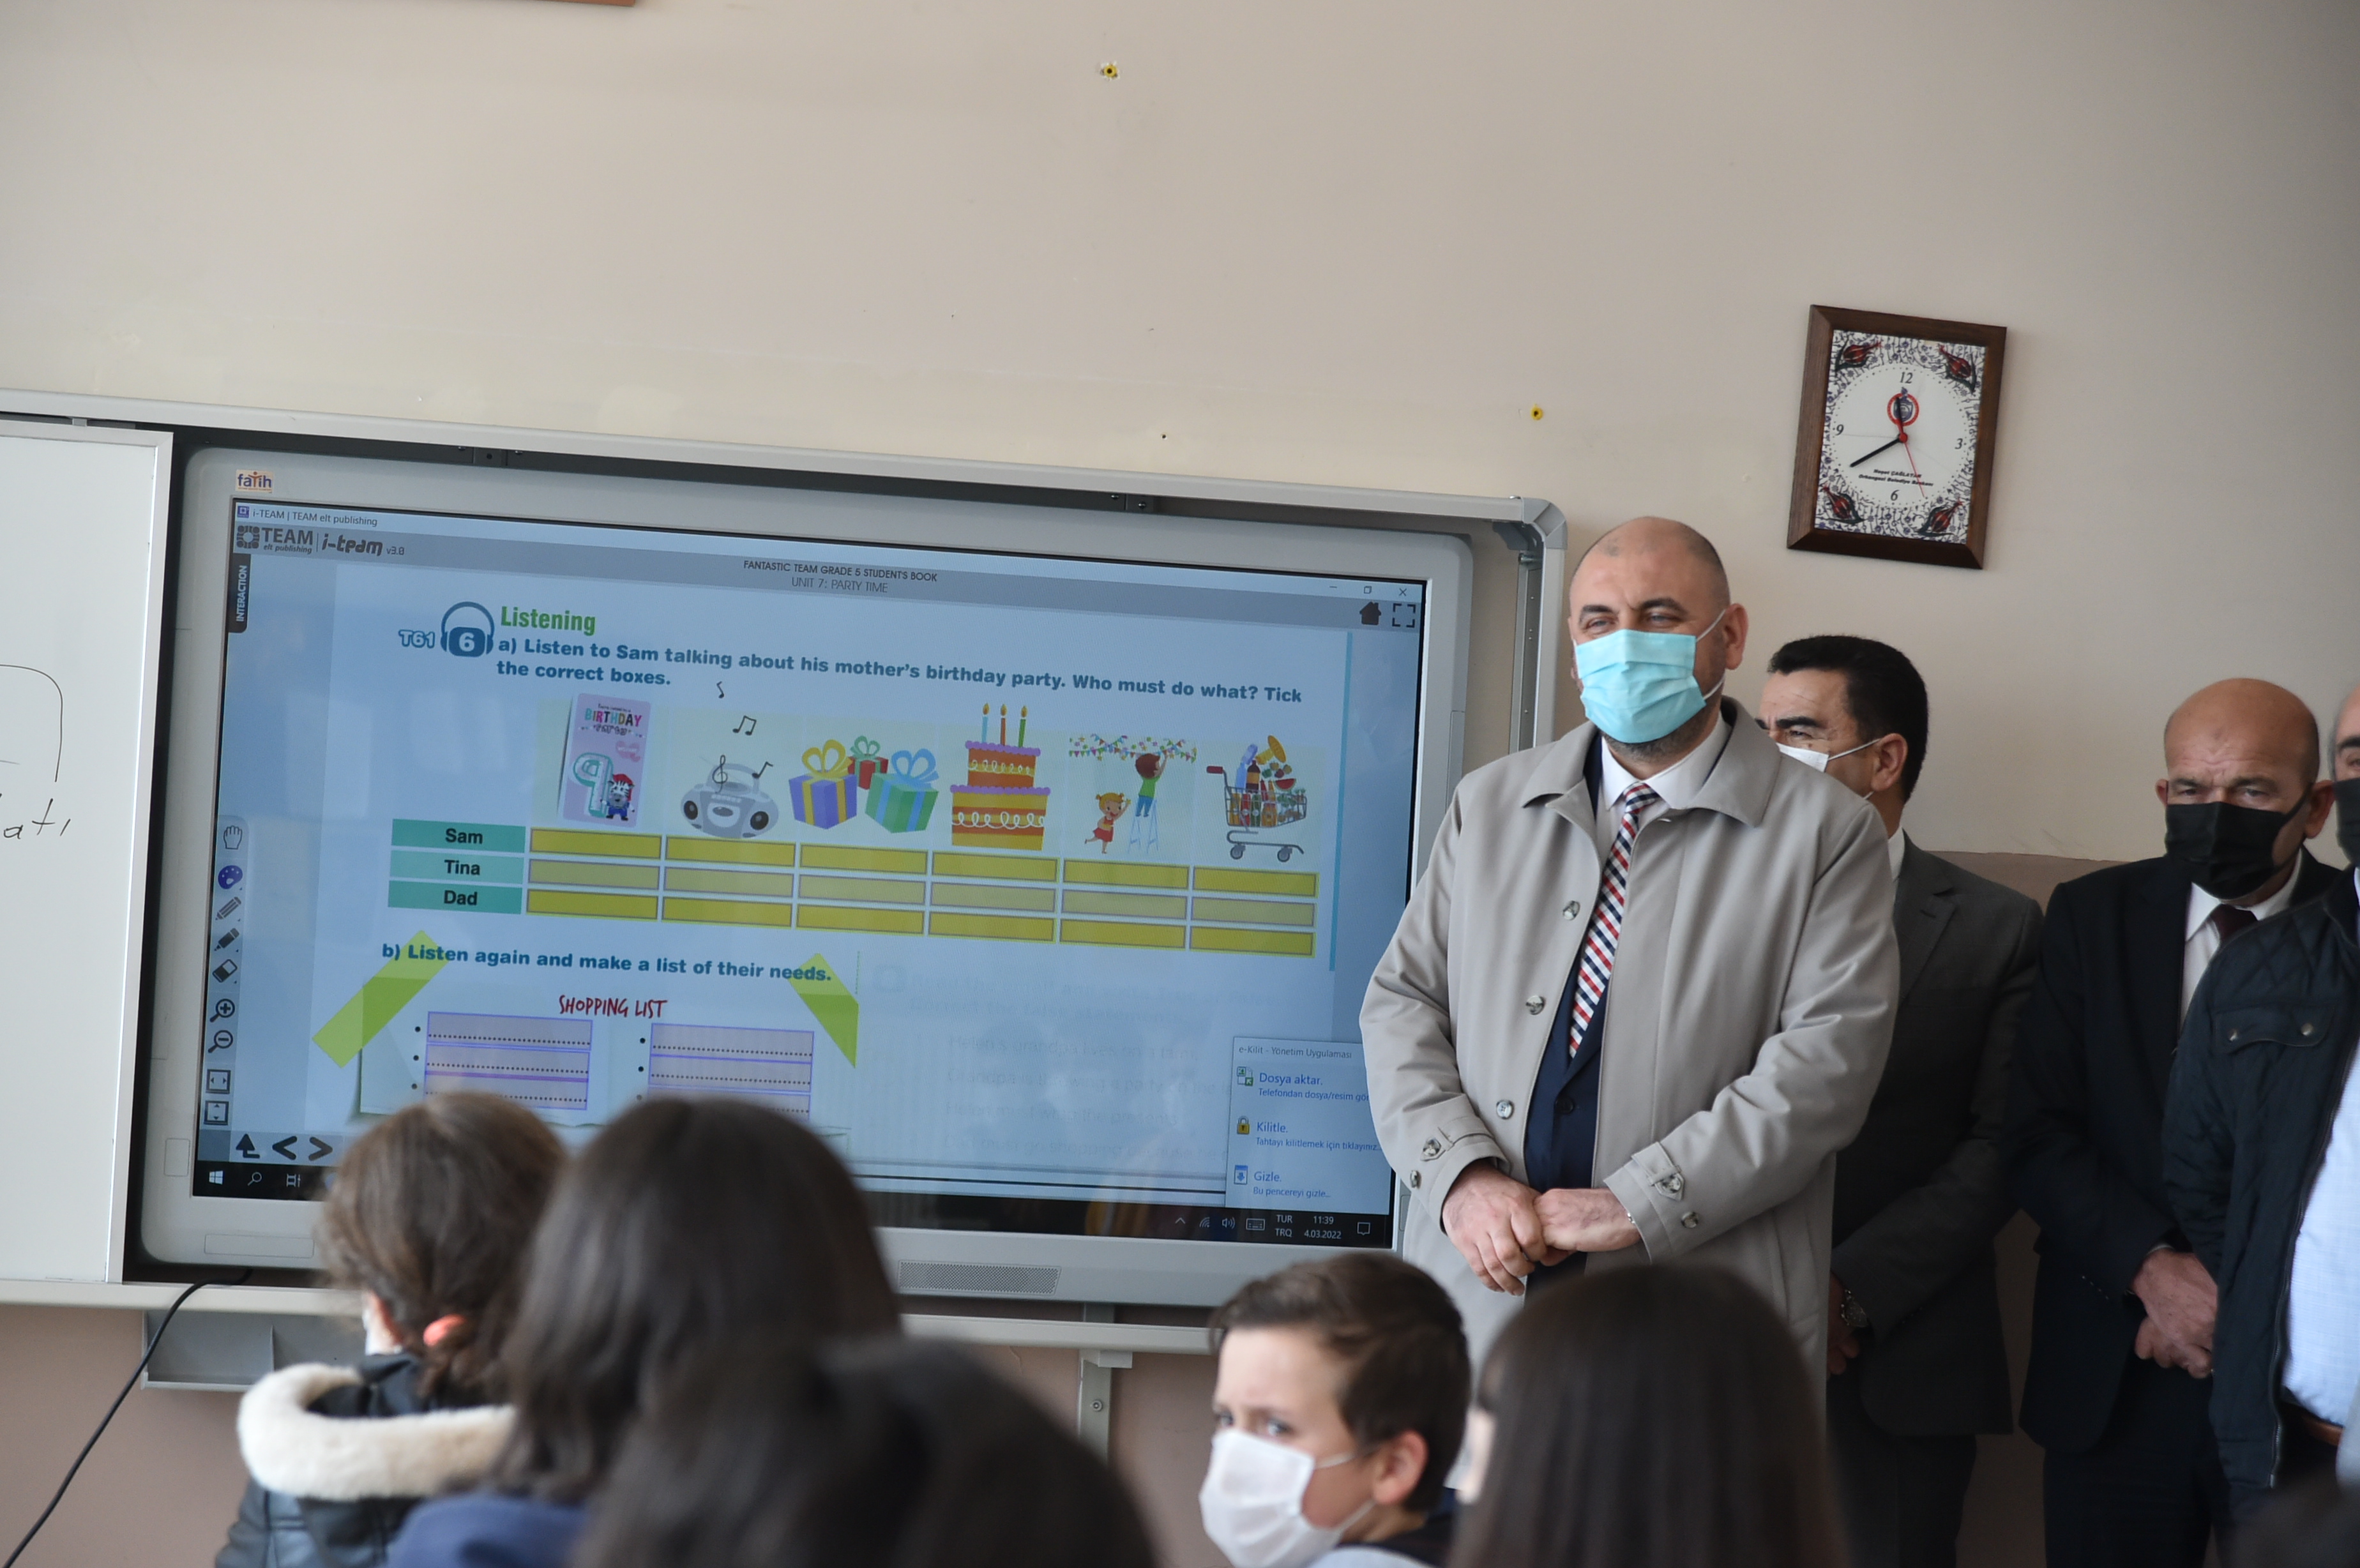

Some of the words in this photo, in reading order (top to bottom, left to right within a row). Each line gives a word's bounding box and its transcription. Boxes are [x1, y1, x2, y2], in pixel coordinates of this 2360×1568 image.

[1899, 372, 1913, 384] 12
[1835, 425, 1844, 436] 9
[1955, 439, 1963, 451] 3
[1891, 490, 1900, 501] 6
[253, 509, 285, 518] i-TEAM
[292, 512, 317, 522] TEAM
[319, 513, 331, 522] elt
[333, 515, 378, 527] publishing
[262, 527, 313, 545] TEAM
[275, 545, 312, 554] publishing
[386, 546, 405, 555] v3.0
[743, 561, 790, 571] FANTASTIC
[794, 564, 818, 573] TEAM
[820, 566, 852, 576] GRADE
[911, 571, 937, 582] BOOK
[791, 577, 814, 587] UNIT
[818, 578, 828, 589] 7:
[831, 579, 863, 591] PARTY
[865, 582, 888, 593] TIME
[236, 565, 248, 622] INTERACTION
[501, 606, 596, 636] Listening
[398, 629, 435, 649] T61
[498, 640, 517, 655] a)
[524, 639, 584, 656] Listen
[590, 644, 610, 658] to
[616, 645, 658, 661] Sam
[665, 648, 732, 669] talking
[739, 654, 794, 670] about
[801, 656, 829, 672] his
[835, 661, 920, 679] mother's
[926, 665, 1006, 688] birthday
[1011, 672, 1066, 691] party.
[1073, 674, 1112, 691] Who
[1118, 681, 1165, 695] must
[1172, 682, 1194, 696] do
[1201, 684, 1259, 700] what?
[1264, 687, 1302, 702] Tick
[497, 661, 529, 677] the
[535, 666, 604, 682] correct
[610, 668, 671, 685] boxes.
[585, 708, 642, 727] BIRTHDAY
[445, 828, 483, 844] Sam
[444, 859, 480, 875] Tina
[444, 890, 478, 905] Dad
[382, 944, 401, 961] b)
[408, 945, 468, 961] Listen
[474, 951, 530, 967] again
[537, 954, 573, 967] and
[580, 956, 632, 970] make
[639, 960, 650, 971] a
[656, 958, 686, 973] list
[693, 960, 712, 974] of
[718, 961, 764, 977] their
[770, 965, 832, 981] needs.
[559, 995, 628, 1018] SHOPPING
[635, 1000, 668, 1018] LIST
[1271, 1047, 1304, 1057] Yönetim
[1306, 1049, 1352, 1059] Uygulaması
[1259, 1073, 1291, 1087] Dosya
[1294, 1074, 1324, 1086] aktar.
[1259, 1088, 1303, 1098] Telefondan
[1305, 1090, 1354, 1101] dosya/resim
[1257, 1122, 1289, 1133] Kilitle.
[1256, 1137, 1283, 1147] Tahtayı
[1285, 1139, 1324, 1149] kilitlemek
[1326, 1141, 1340, 1150] için
[1253, 1172, 1282, 1183] Gizle.
[1266, 1189, 1304, 1198] pencereyi
[1276, 1214, 1293, 1223] TUR
[1313, 1216, 1335, 1225] 11:39
[1275, 1228, 1292, 1239] TRQ
[1304, 1230, 1342, 1240] 4.03.2022
